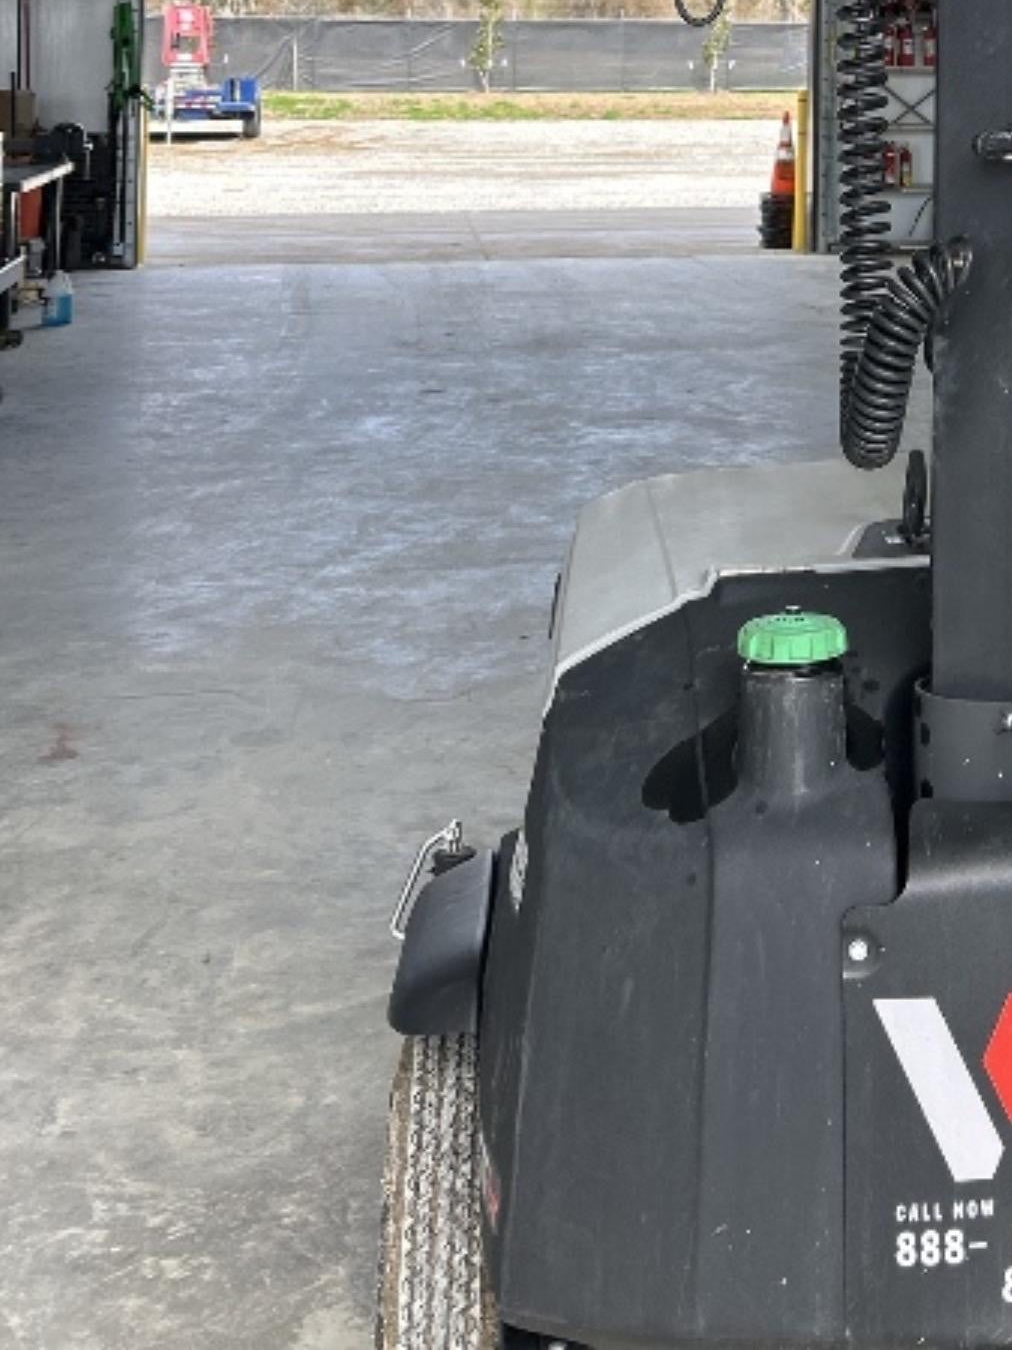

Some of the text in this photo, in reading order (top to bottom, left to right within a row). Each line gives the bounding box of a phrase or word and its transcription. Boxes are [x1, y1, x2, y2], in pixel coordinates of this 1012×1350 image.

[896, 1199, 995, 1222] CALL NOW
[896, 1229, 989, 1267] 888-
